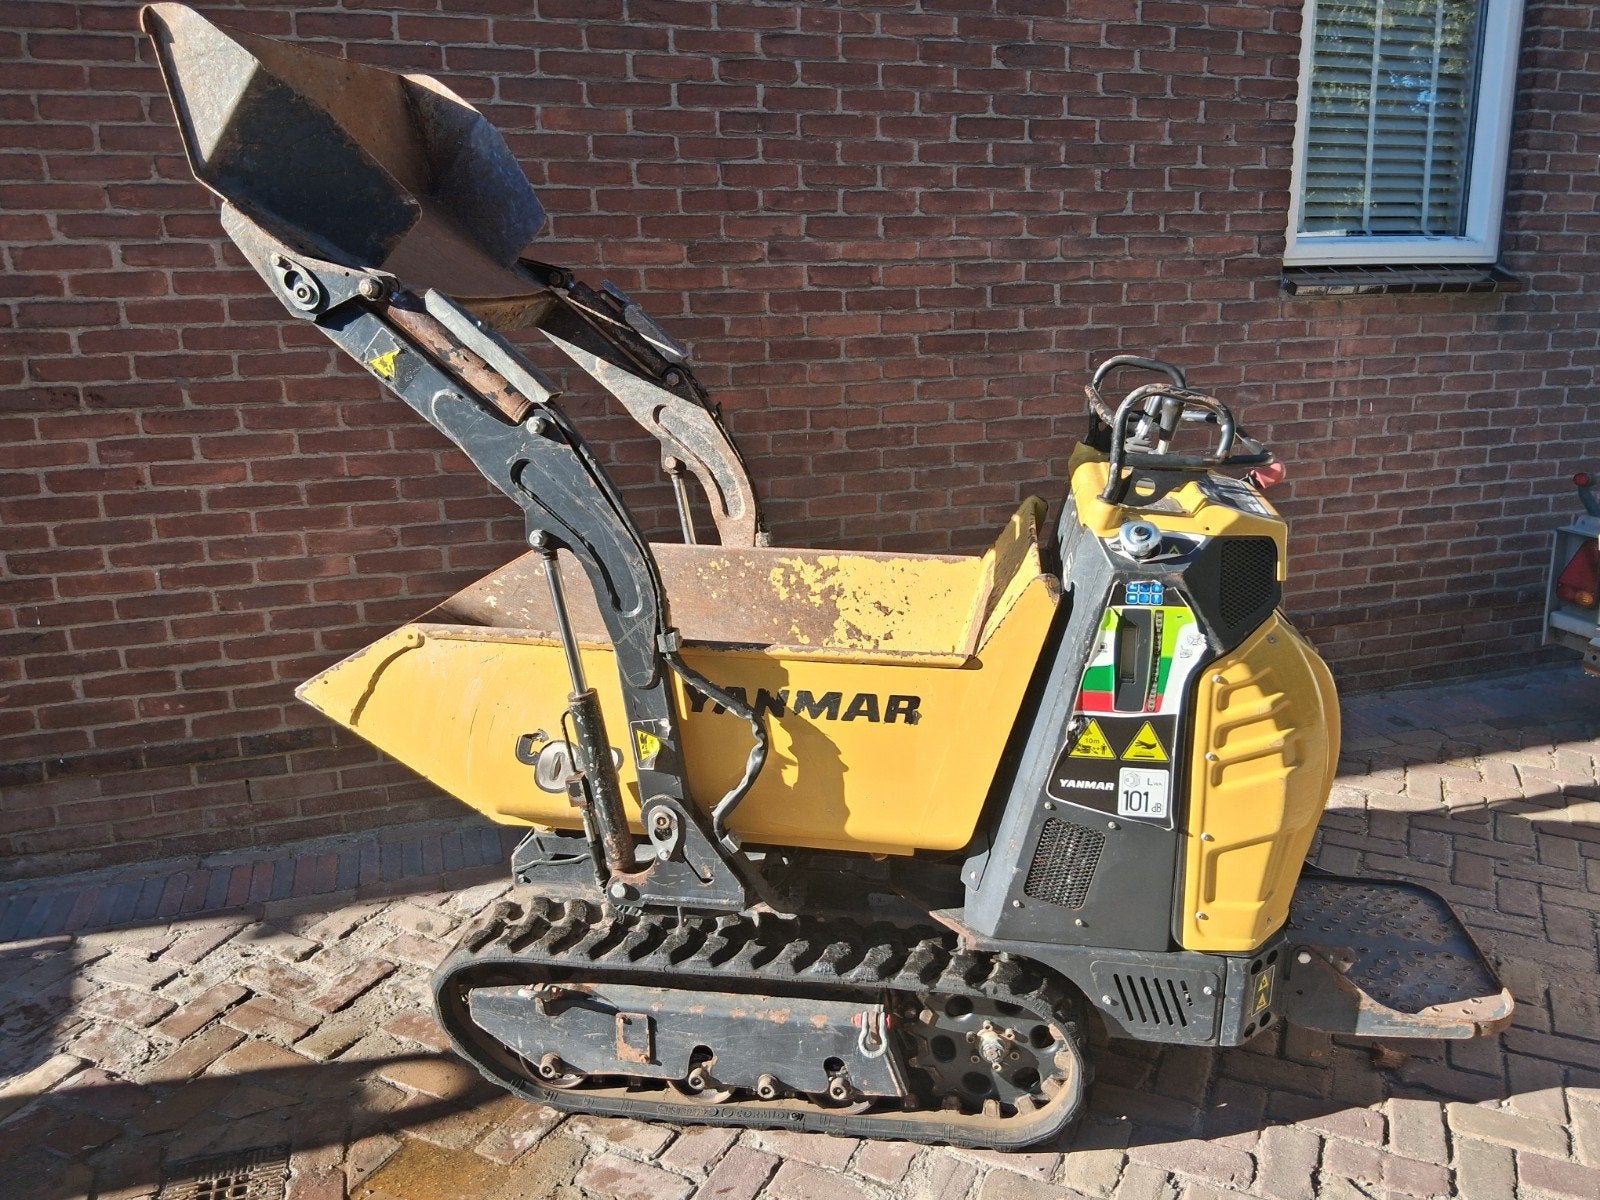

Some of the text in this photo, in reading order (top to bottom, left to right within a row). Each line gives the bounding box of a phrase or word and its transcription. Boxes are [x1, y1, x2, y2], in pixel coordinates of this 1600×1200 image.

[1059, 778, 1115, 791] YANMAR
[1123, 789, 1162, 813] 101 dB
